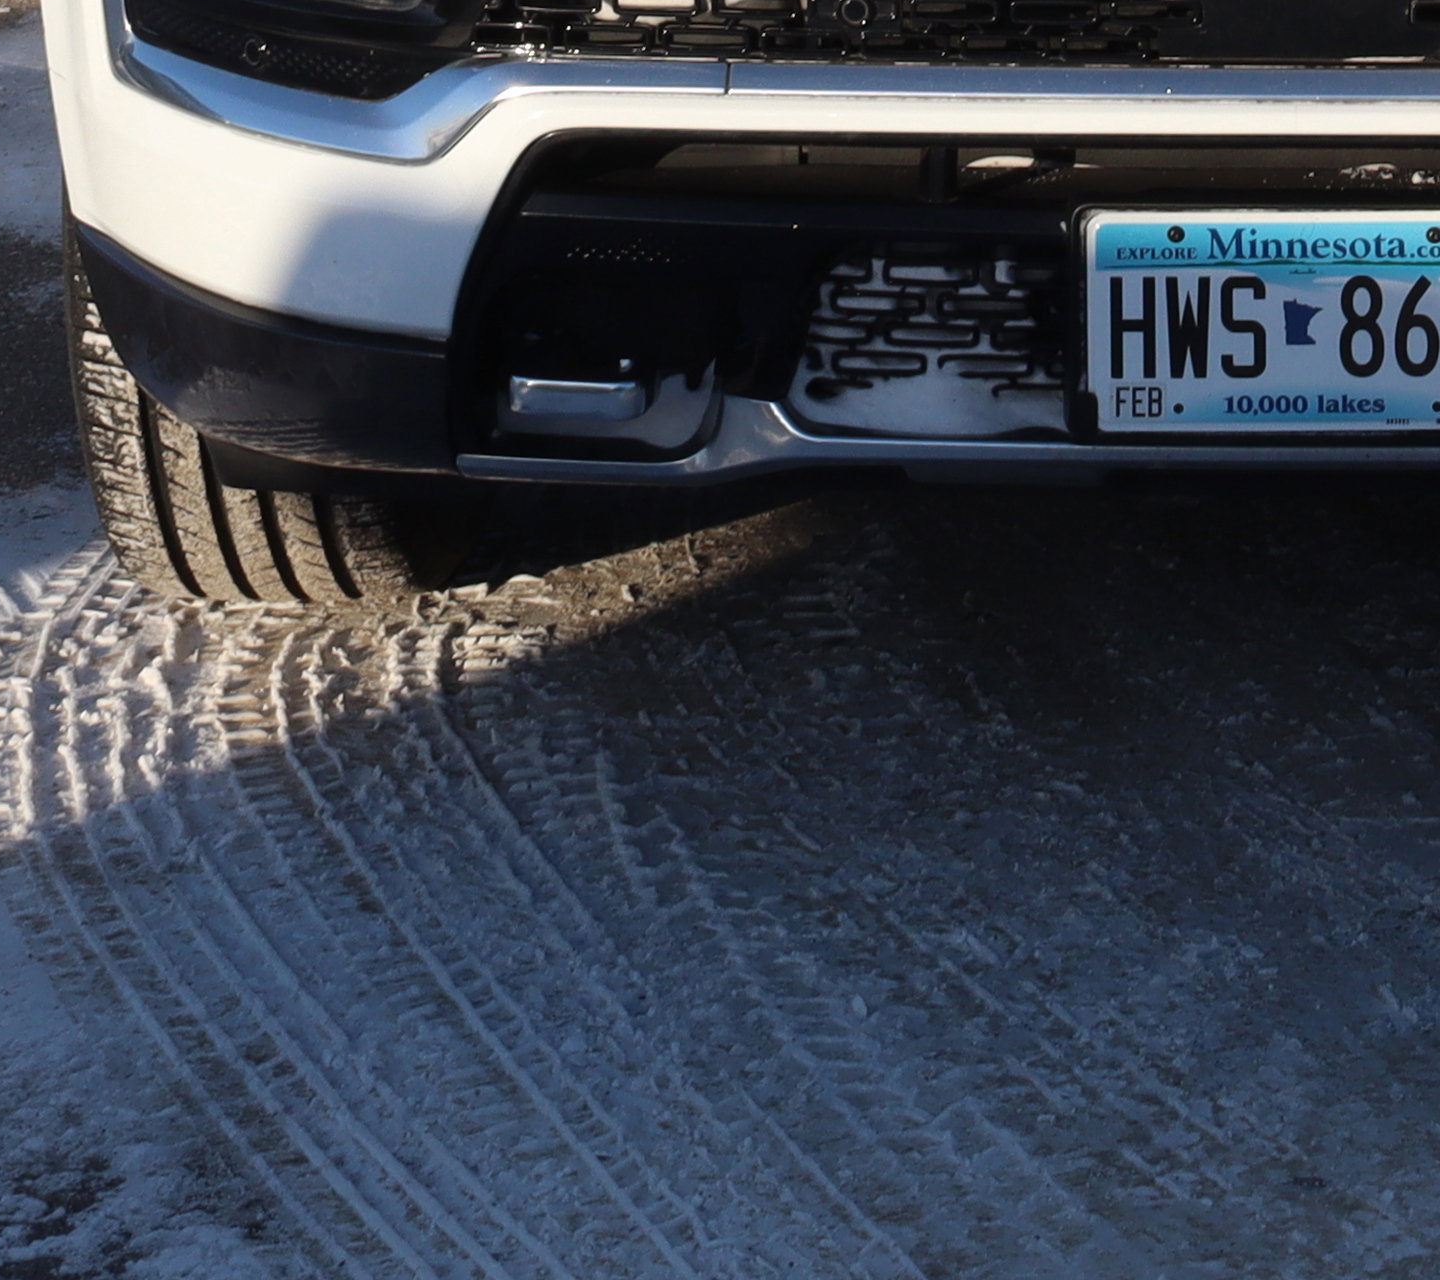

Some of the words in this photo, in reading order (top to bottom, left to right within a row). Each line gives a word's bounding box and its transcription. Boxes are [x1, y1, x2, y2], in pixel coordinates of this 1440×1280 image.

[1115, 246, 1198, 261] EXPLORE
[1109, 276, 1267, 379] HWS
[1114, 386, 1163, 418] FEB
[1222, 395, 1308, 417] 10,000
[1316, 394, 1386, 415] lakes
